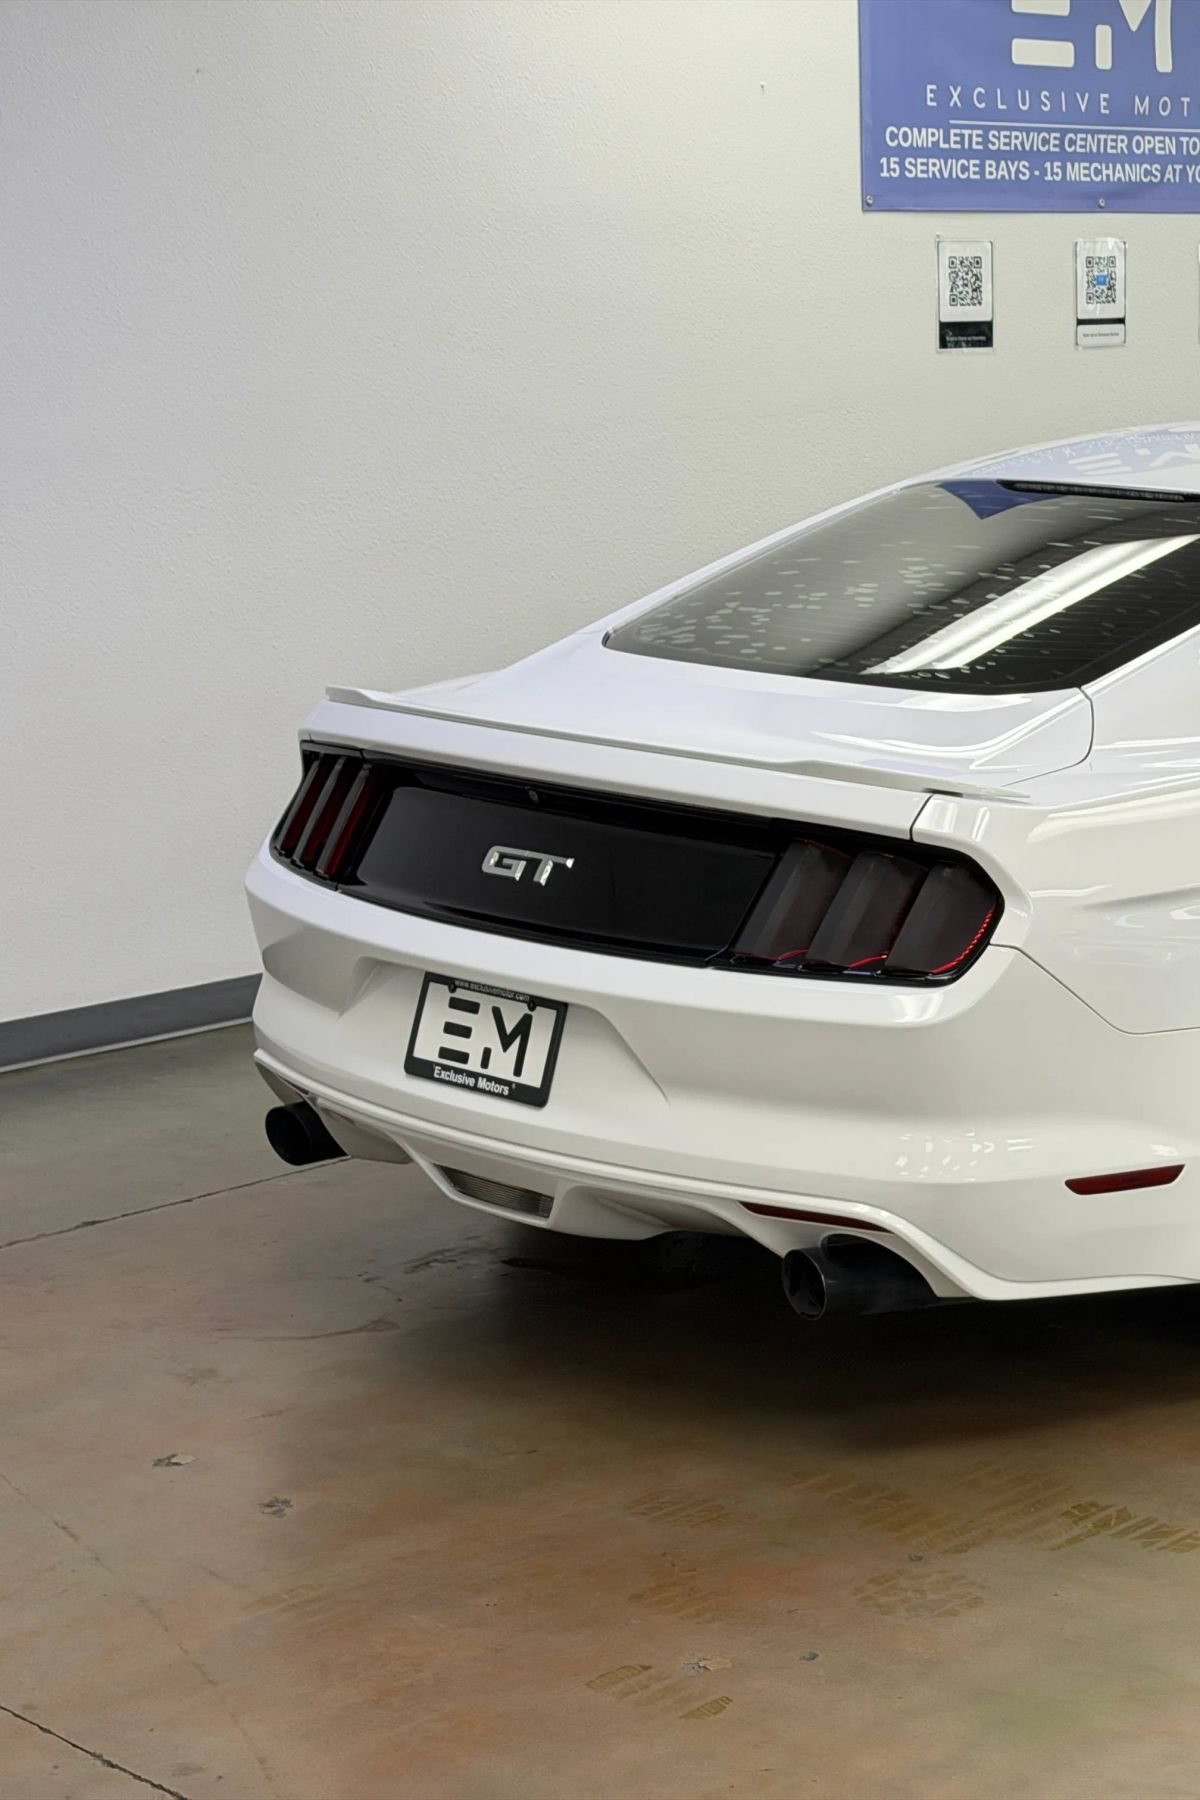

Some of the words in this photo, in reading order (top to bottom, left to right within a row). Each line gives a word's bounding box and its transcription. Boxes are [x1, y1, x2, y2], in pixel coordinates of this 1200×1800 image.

[926, 84, 1110, 114] EXCLUSIVE
[885, 126, 984, 149] COMPLETE
[988, 130, 1060, 152] SERVICE
[1064, 132, 1128, 154] CENTER
[1132, 135, 1176, 155] OPEN
[1179, 136, 1200, 156] TO
[879, 157, 900, 178] 15
[904, 158, 980, 179] SERVICE
[985, 159, 1030, 181] BAYS
[1044, 161, 1062, 181] 15
[1066, 161, 1161, 183] MECHANICS
[1164, 164, 1183, 184] AT
[482, 845, 575, 886] GT
[438, 996, 534, 1078] EM
[433, 1066, 476, 1088] Exclusive
[477, 1076, 510, 1097] Motors
